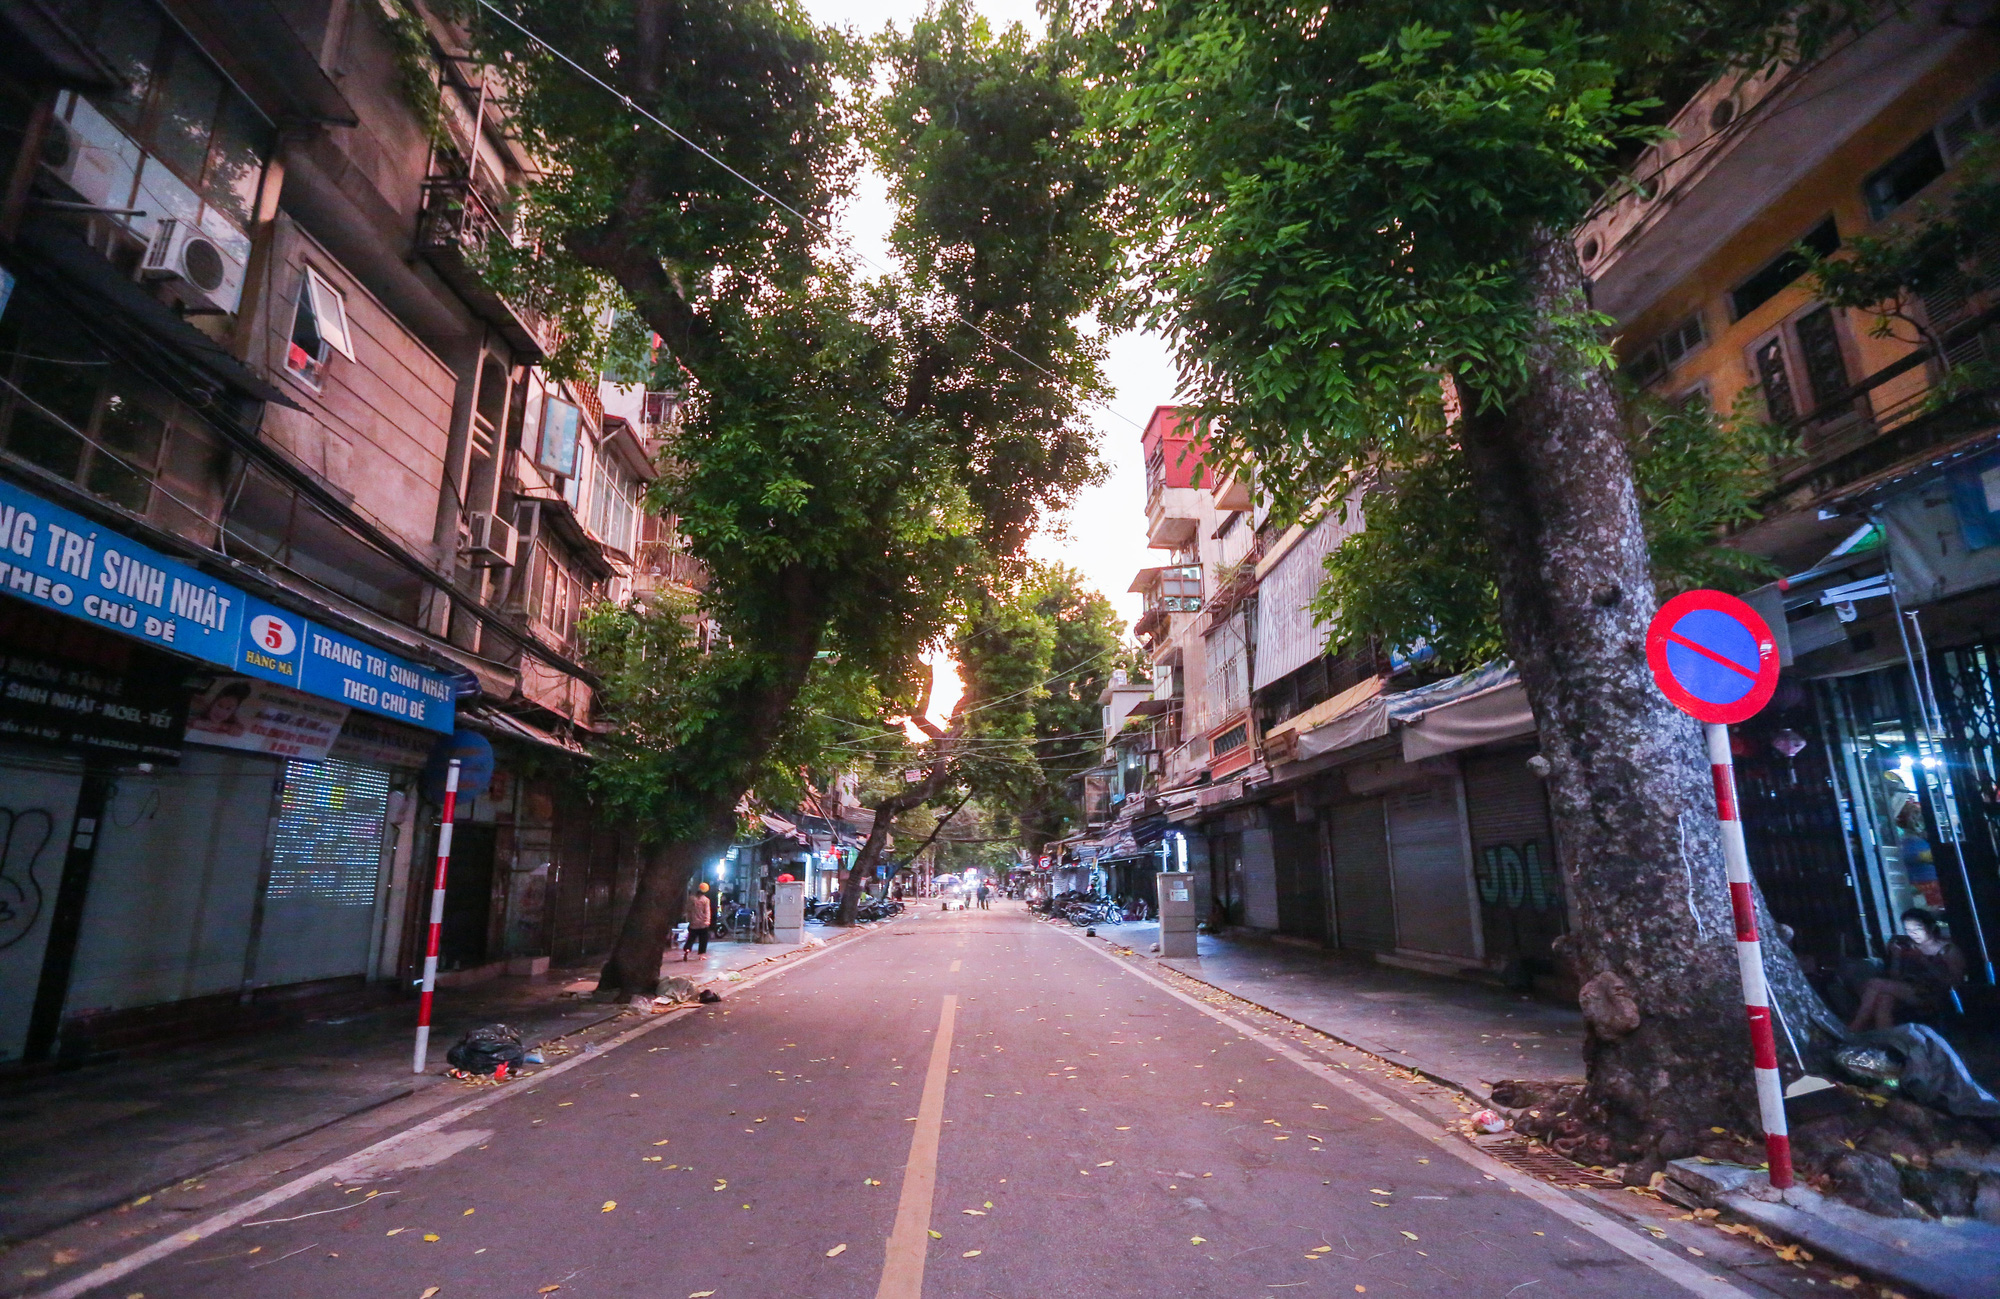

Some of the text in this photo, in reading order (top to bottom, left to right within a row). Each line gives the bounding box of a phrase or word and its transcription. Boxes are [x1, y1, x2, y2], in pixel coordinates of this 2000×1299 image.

[47, 523, 97, 580] TRÍ
[100, 549, 167, 608] SINH
[169, 577, 231, 635] NHẬT
[83, 595, 138, 629] CHỦ
[144, 616, 176, 642] ĐỀ
[265, 620, 283, 649] 5
[245, 650, 276, 671] HÀNG
[313, 634, 451, 703] TRANG TRÍ SINH NHẬT
[343, 678, 378, 706] THEO
[381, 690, 407, 715] CHỦ
[409, 699, 425, 721] ĐỀ
